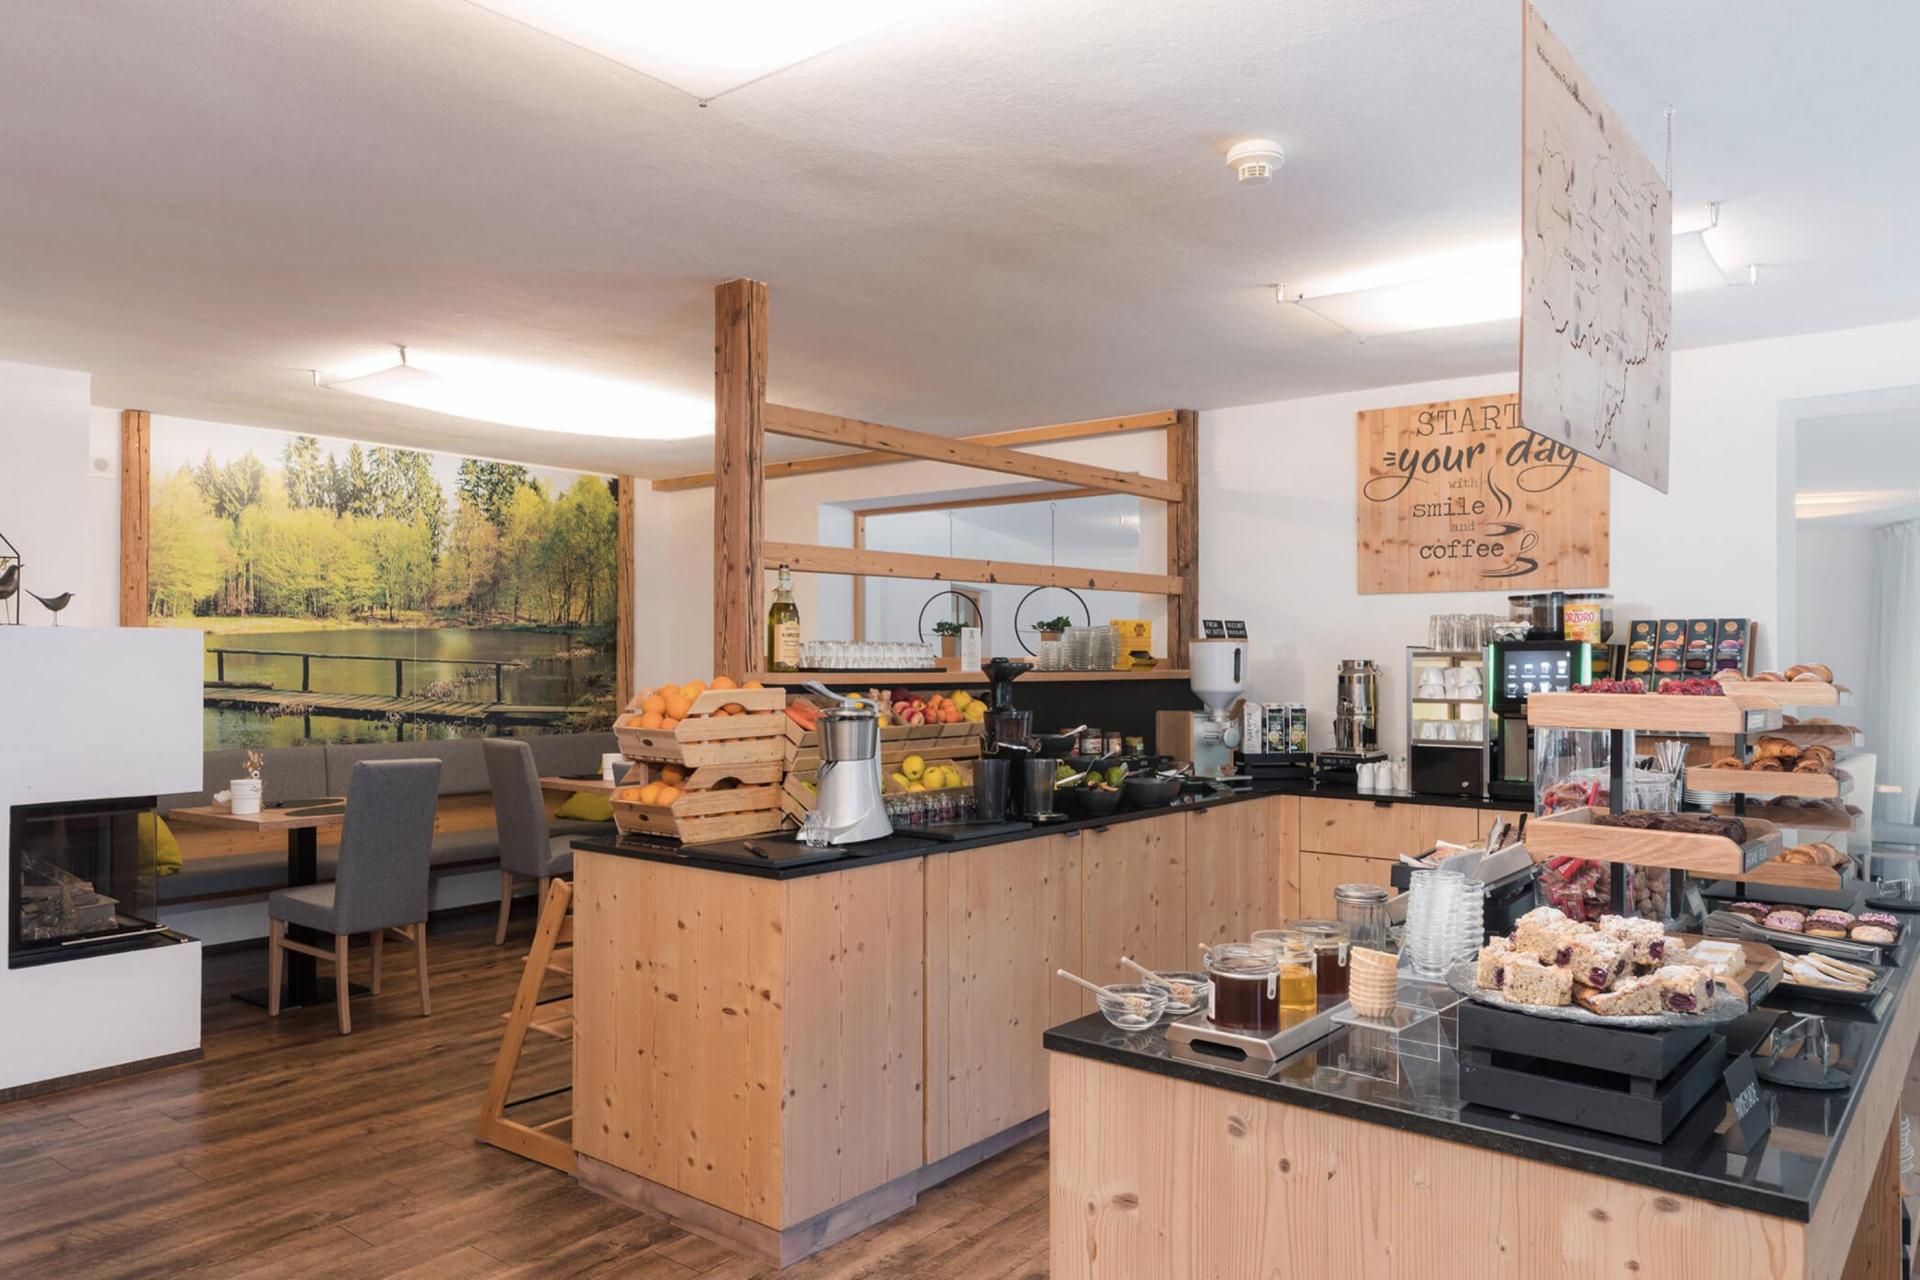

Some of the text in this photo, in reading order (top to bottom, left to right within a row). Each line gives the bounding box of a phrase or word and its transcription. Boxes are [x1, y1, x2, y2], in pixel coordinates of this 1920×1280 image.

[1416, 403, 1520, 437] START
[1364, 432, 1592, 502] your day
[1448, 477, 1478, 489] with
[1412, 497, 1485, 518] smile
[1450, 521, 1475, 532] and
[1419, 540, 1504, 560] coffee
